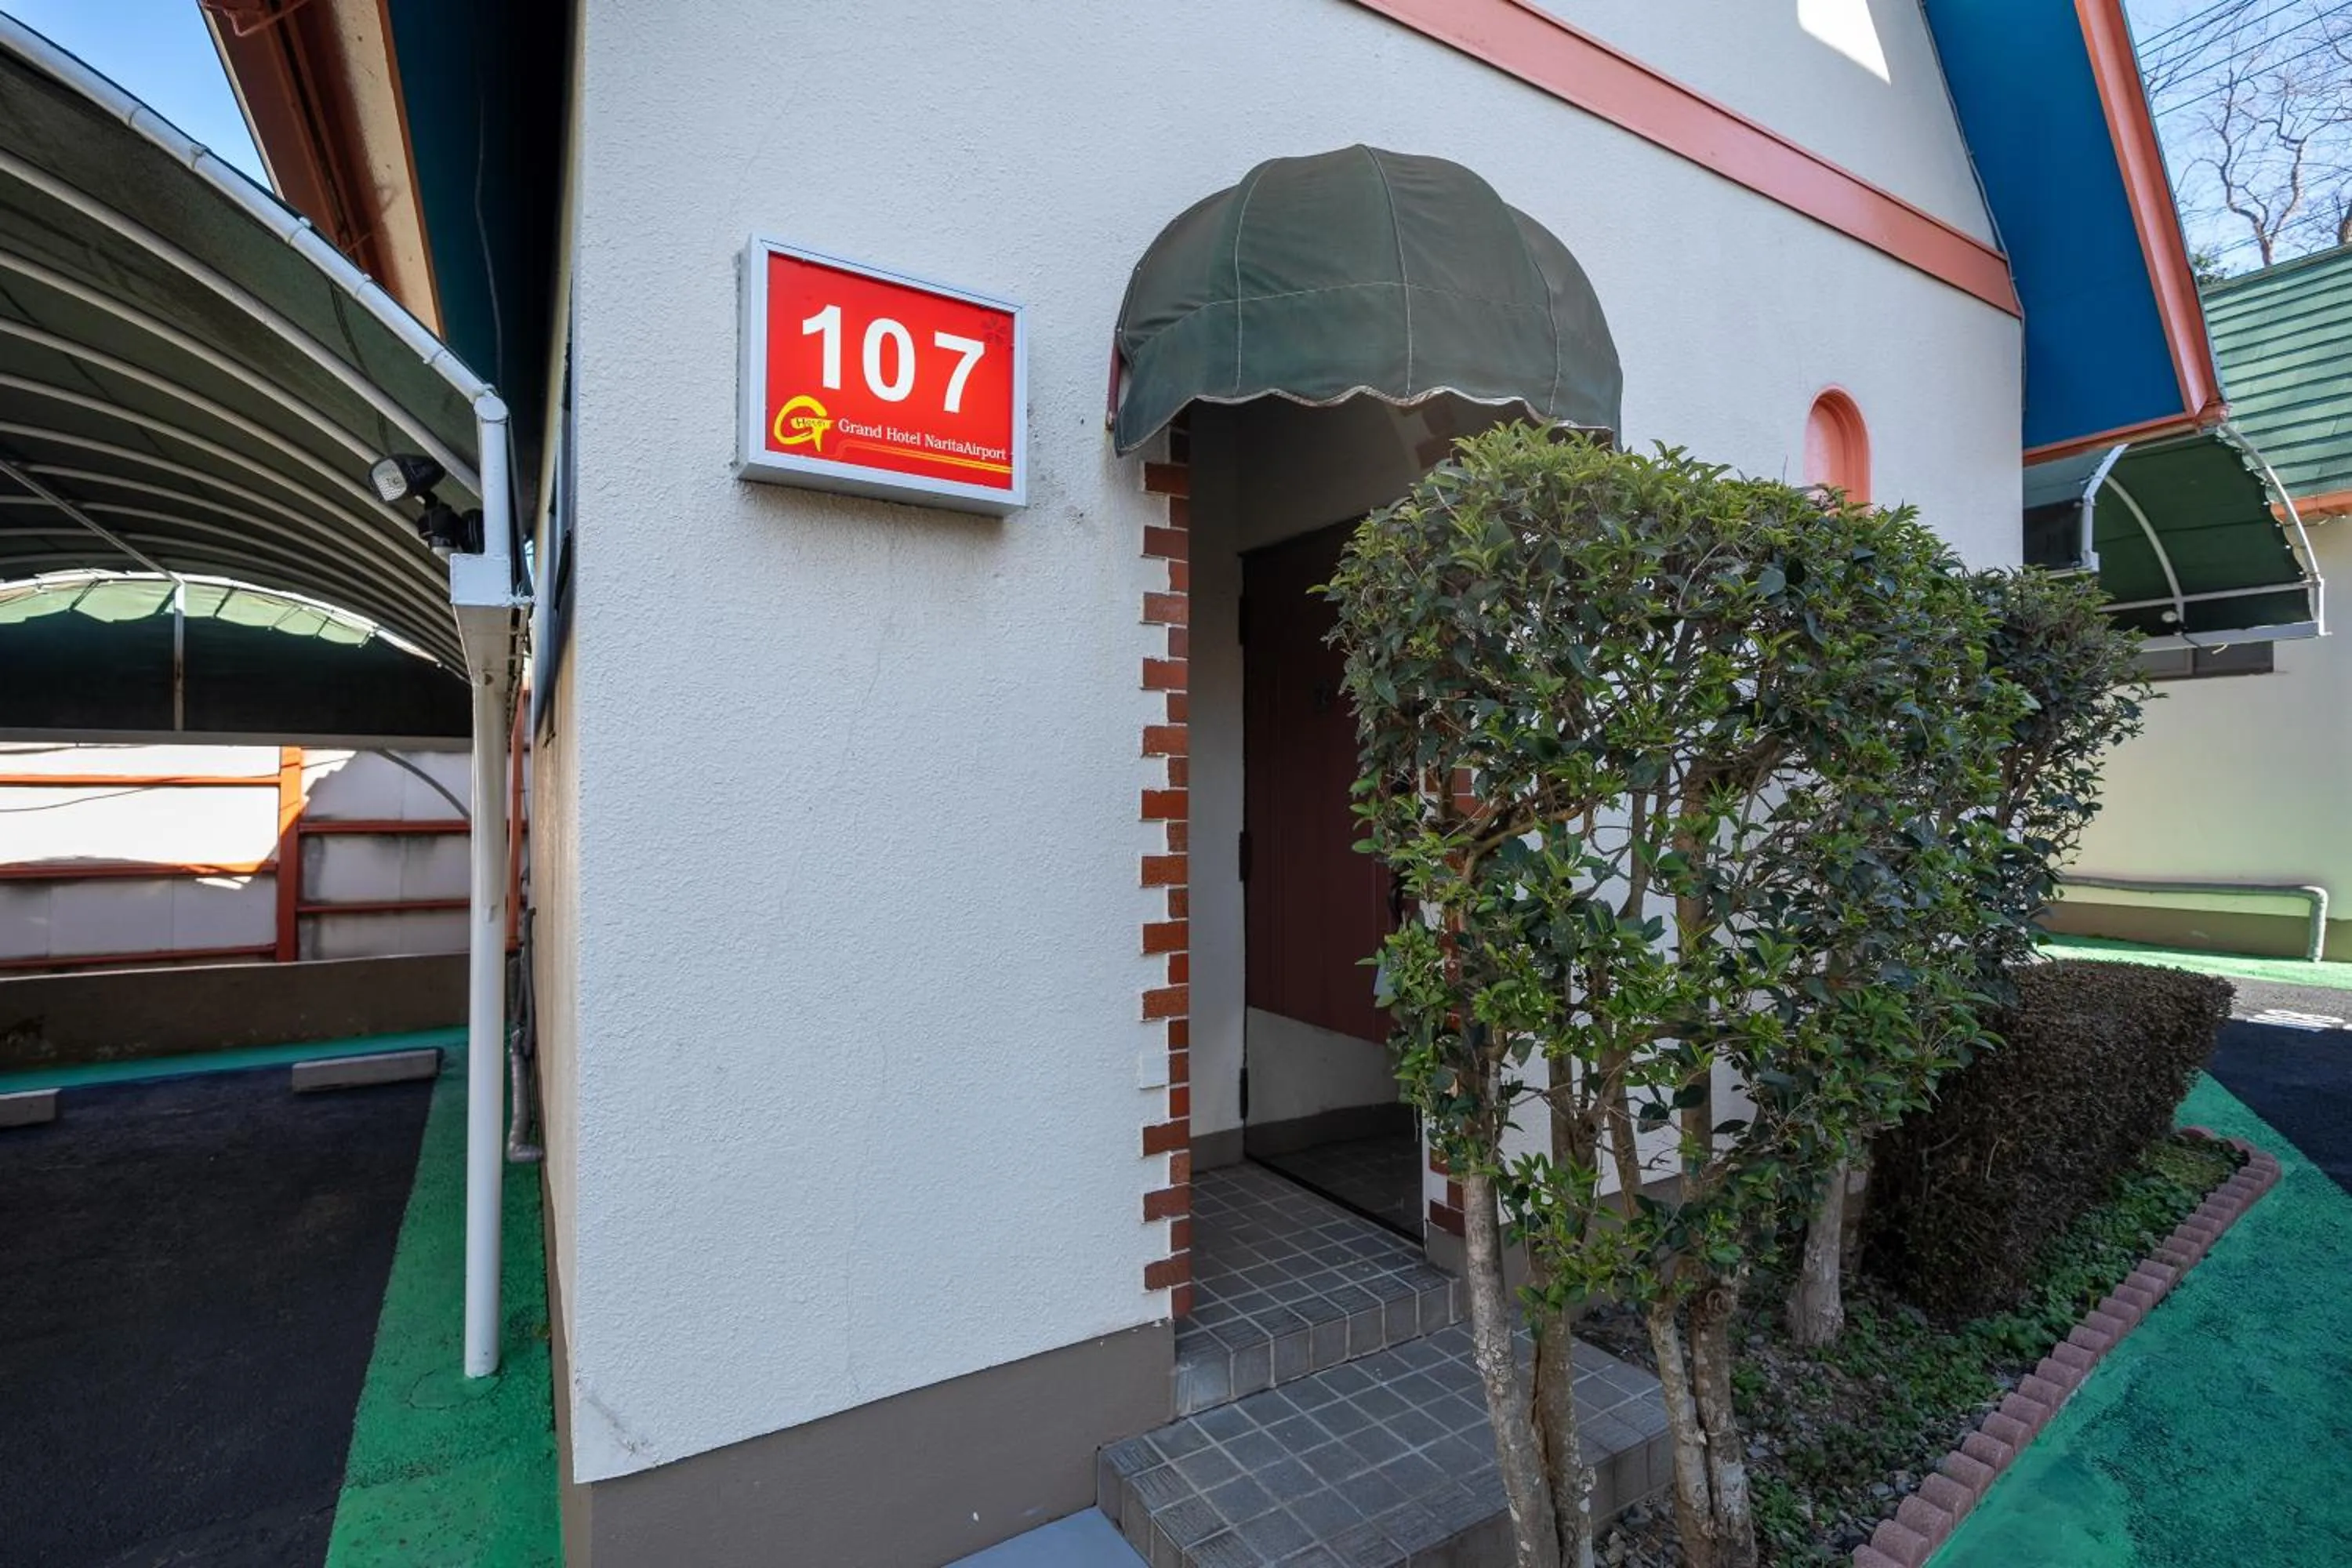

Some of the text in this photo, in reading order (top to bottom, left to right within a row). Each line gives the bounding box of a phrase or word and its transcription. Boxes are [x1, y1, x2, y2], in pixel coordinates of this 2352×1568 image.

[802, 303, 985, 414] 107
[838, 418, 1007, 460] Grand Hotel NaritaAirport
